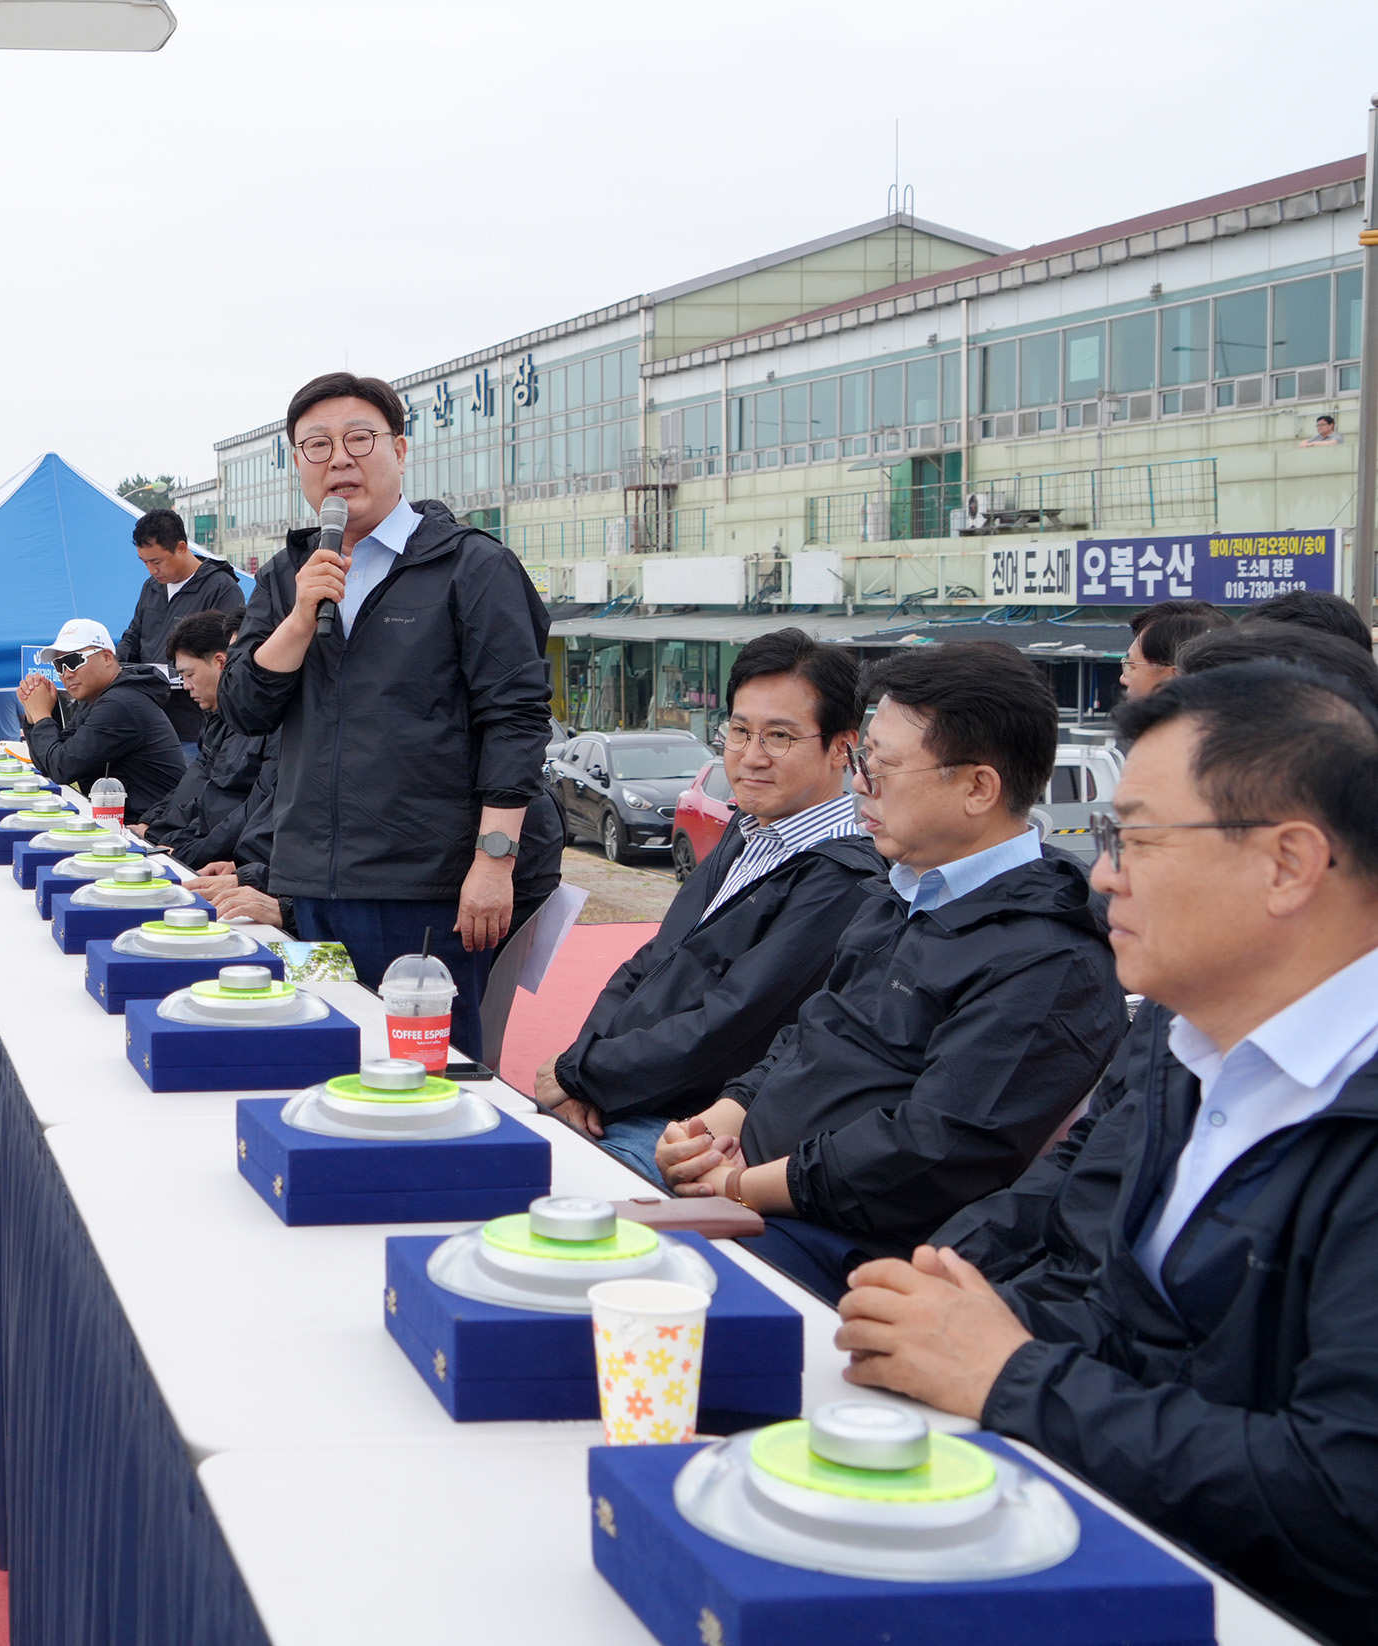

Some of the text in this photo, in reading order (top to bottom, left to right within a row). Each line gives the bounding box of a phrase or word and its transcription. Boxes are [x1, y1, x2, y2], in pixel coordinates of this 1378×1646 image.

[992, 551, 1018, 595] 전어
[1083, 544, 1195, 597] 오복수산
[1272, 559, 1294, 578] 전문
[392, 1029, 423, 1040] COFFEE
